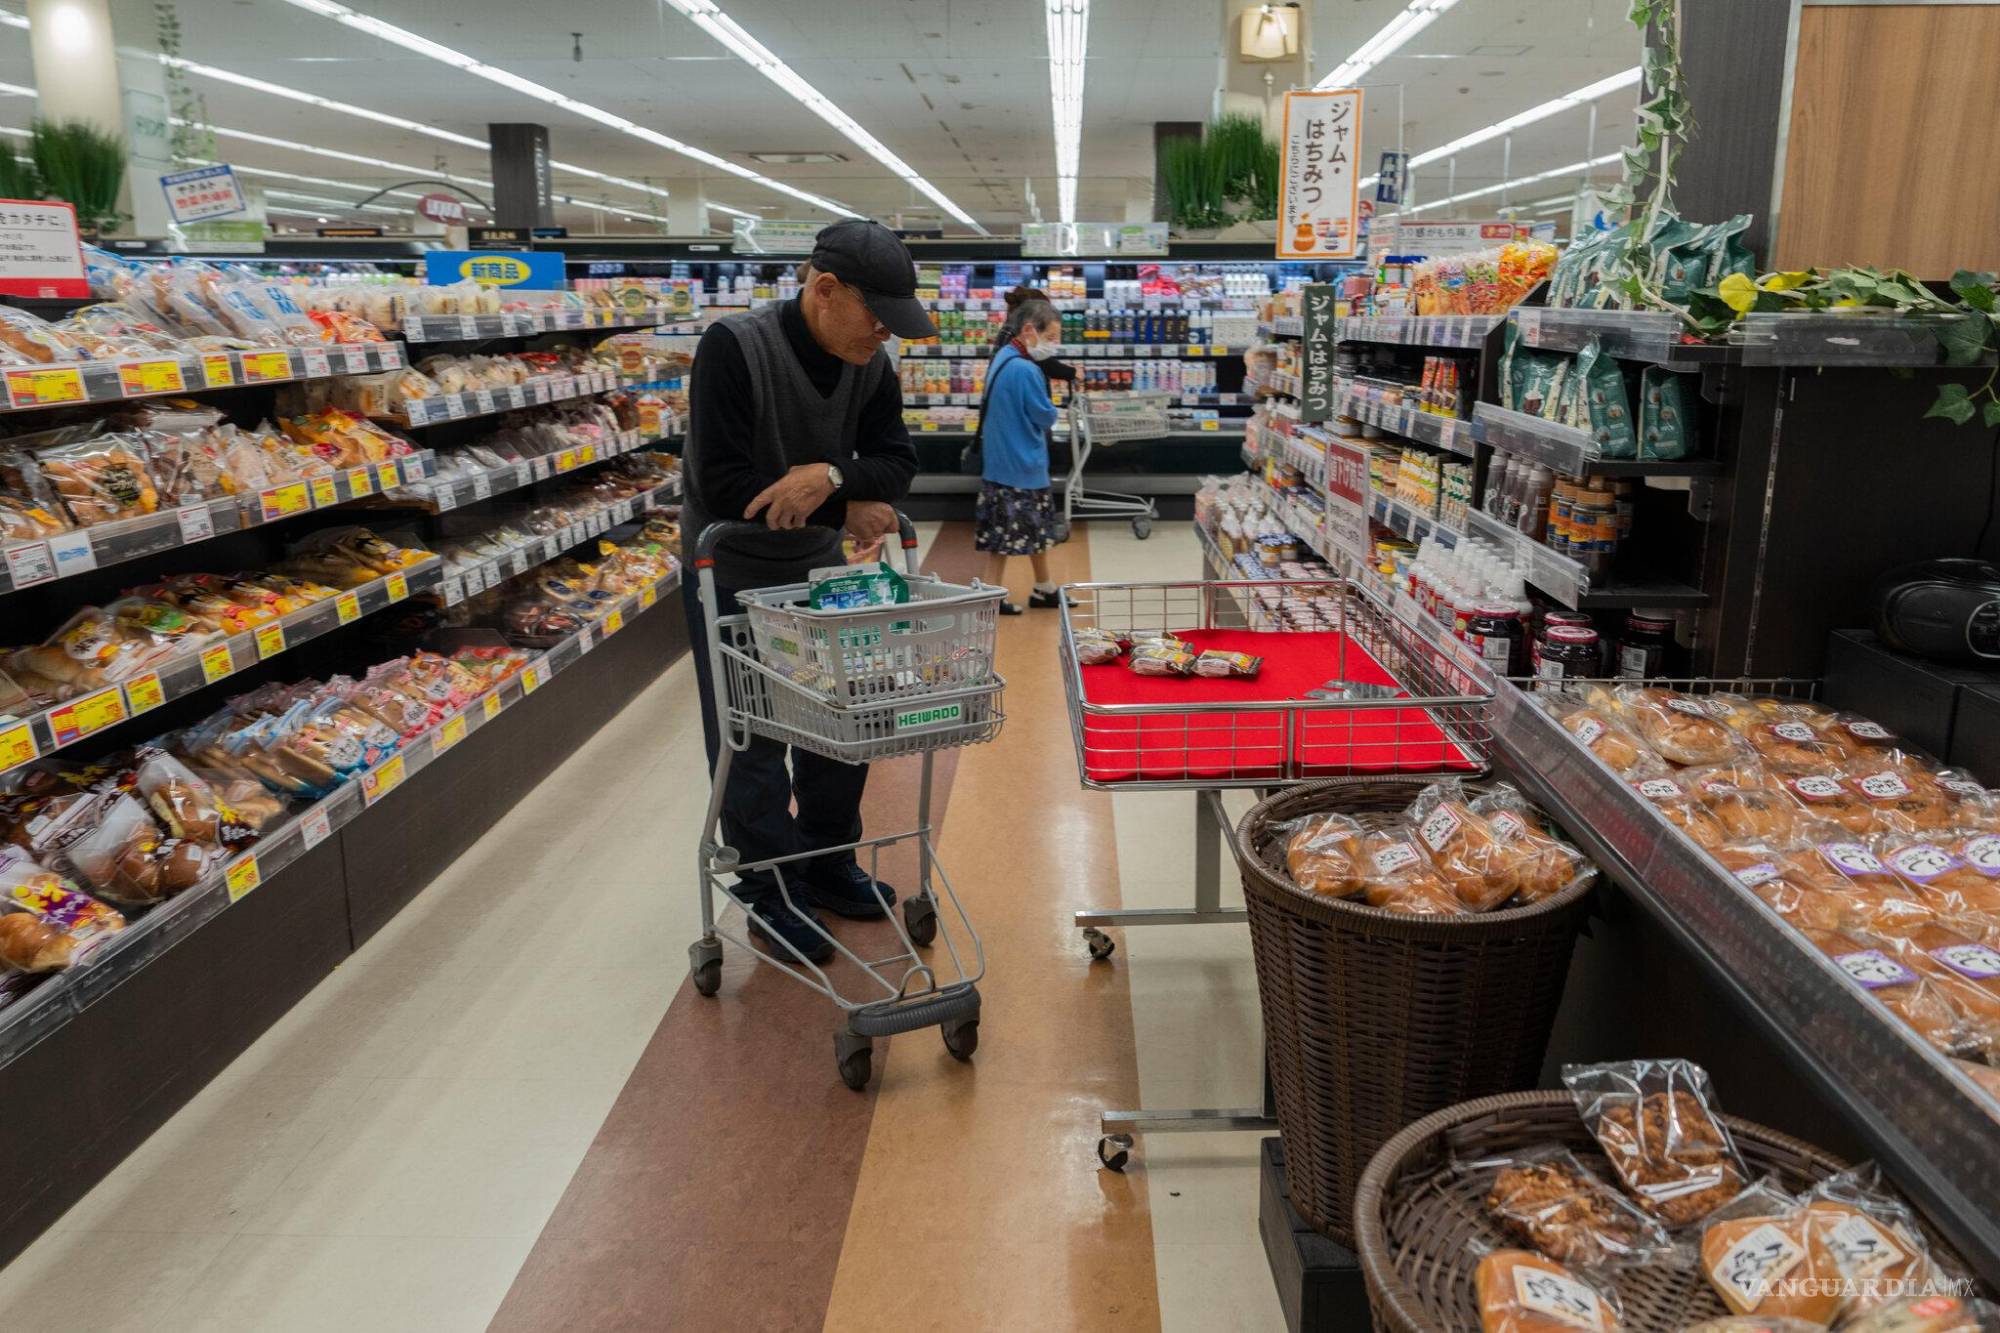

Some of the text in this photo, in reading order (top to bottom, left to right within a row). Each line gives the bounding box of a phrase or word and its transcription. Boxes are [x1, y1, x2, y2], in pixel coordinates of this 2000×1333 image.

[1302, 119, 1326, 204] はちみつ
[1328, 100, 1352, 175] ジャム・
[471, 263, 520, 279] 新商品
[1307, 296, 1330, 412] ジャム・はちみつ
[899, 706, 959, 726] HEIWADO
